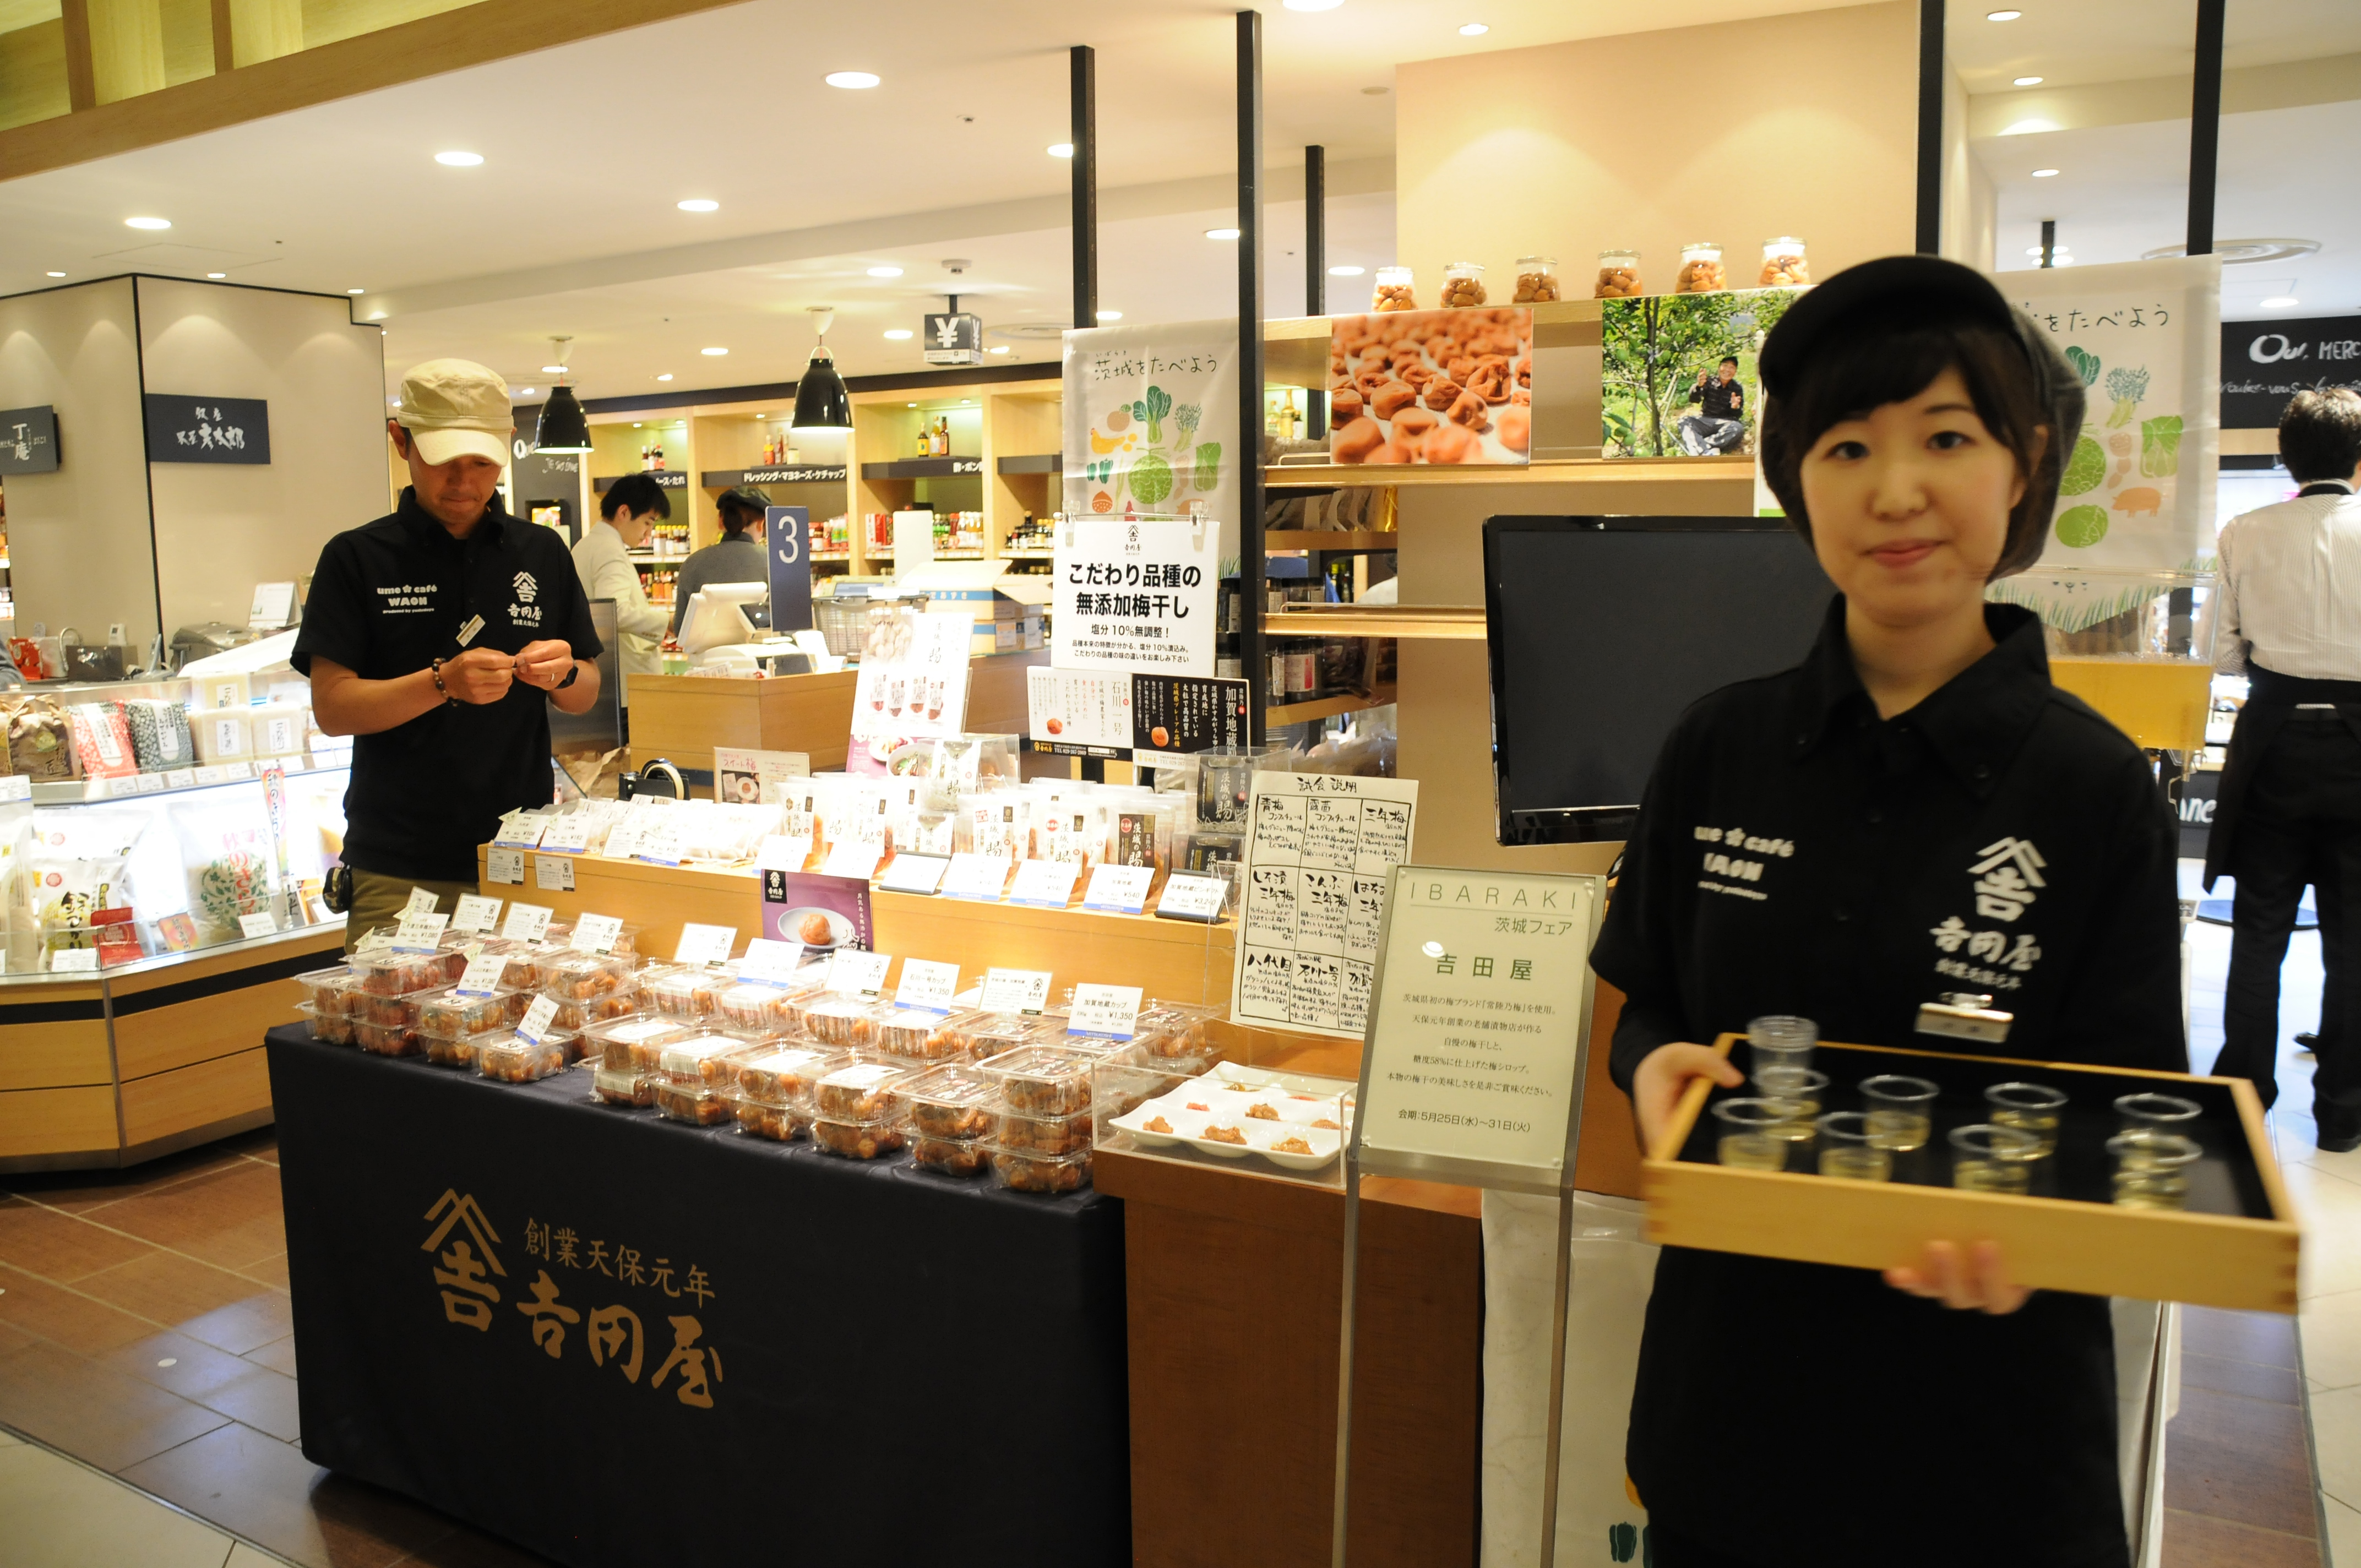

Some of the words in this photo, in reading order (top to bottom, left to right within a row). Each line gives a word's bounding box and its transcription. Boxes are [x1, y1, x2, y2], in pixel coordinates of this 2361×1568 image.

[2033, 304, 2168, 331] をたべよう
[1095, 355, 1217, 380] 茨城をたべよう
[744, 469, 846, 482] ドレッシング・マヨネーズ・ケチャップ
[778, 515, 798, 564] 3
[1069, 563, 1201, 587] こだわり品種の
[414, 584, 437, 593] café
[388, 597, 427, 607] WAON
[1076, 592, 1189, 618] 無添加梅干し
[1091, 624, 1108, 635] 塩分
[1074, 650, 1189, 663] こだわりの品種の味の違いをお楽しみ下さい
[1112, 681, 1122, 736] 石川一号
[1364, 807, 1407, 824] 三年梅
[1410, 883, 1576, 910] IBARAKI
[1360, 899, 1383, 914] 三年
[1495, 917, 1573, 935] 茨城フェア
[1437, 954, 1533, 981] 吉田屋
[910, 974, 946, 984] 石川一号カップ
[1084, 999, 1127, 1009] 加賀地蔵カップ
[1109, 1011, 1133, 1020] ¥1,350
[1412, 1015, 1542, 1033] 天保元年創業の老舗漬物店が作る
[1444, 1038, 1503, 1052] 自慢の梅干しと、
[1413, 1054, 1530, 1074] 糖度58%に仕上げた梅シロップ。
[1387, 1072, 1553, 1097] 本物の梅干の美味しさを是非ご賞味ください。
[525, 1217, 715, 1309] 創業天保元年
